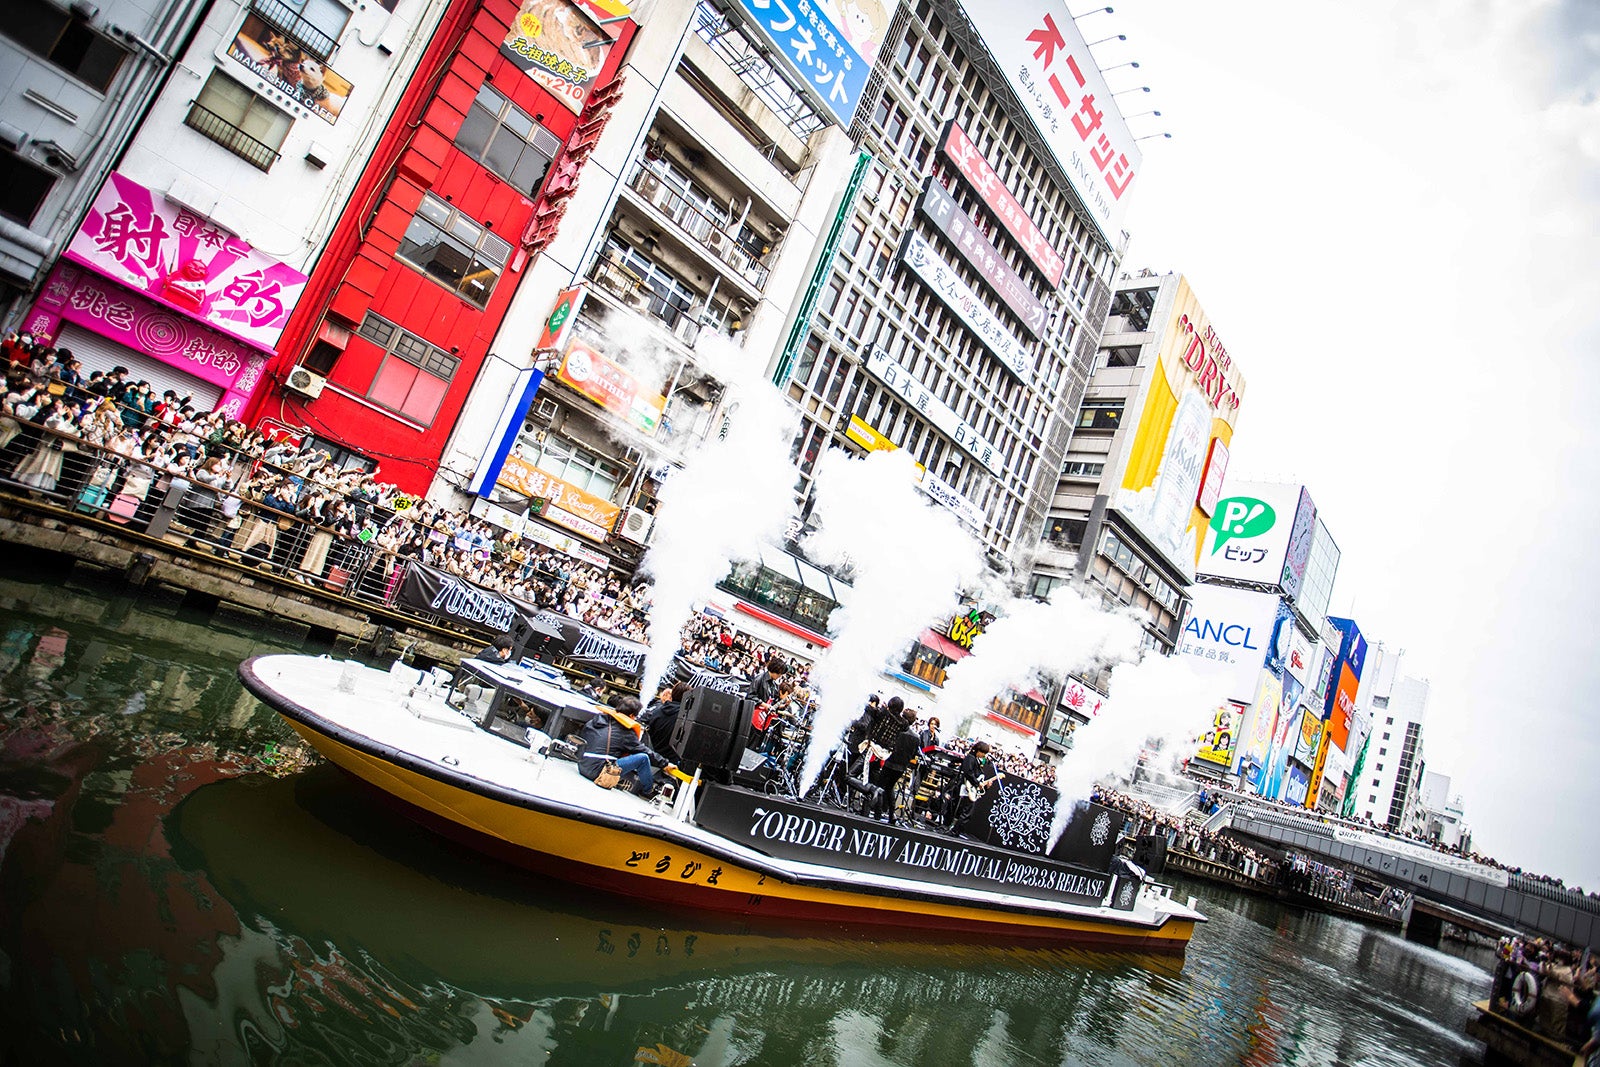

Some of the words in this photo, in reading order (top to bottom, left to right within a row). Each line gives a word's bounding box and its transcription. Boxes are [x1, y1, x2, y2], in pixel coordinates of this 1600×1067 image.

[510, 37, 588, 83] 元祖焼餃子
[232, 48, 301, 101] MAMESHIBA
[304, 97, 337, 125] CAFE
[1025, 12, 1135, 201] 不二サッシ
[929, 187, 951, 217] 7F
[171, 210, 250, 261] 日本一
[70, 284, 135, 332] 桃色
[183, 336, 242, 377] 射的
[1203, 324, 1232, 373] SUPER
[873, 350, 887, 363] 4F
[884, 362, 930, 414] 白木屋
[954, 422, 994, 466] 白木屋
[1170, 436, 1201, 485] Asahi
[1224, 545, 1269, 564] ピップ
[431, 577, 517, 633] 7ORDER
[573, 626, 647, 673] 7ORDER
[1181, 643, 1236, 664] 正直品質。
[1185, 617, 1258, 650] ANCL
[750, 807, 847, 851] 7ORDER
[846, 828, 900, 861] NEW
[895, 840, 960, 876] ALBUM
[1006, 862, 1057, 890] 2023.3.8
[1055, 872, 1106, 898] RELEASE
